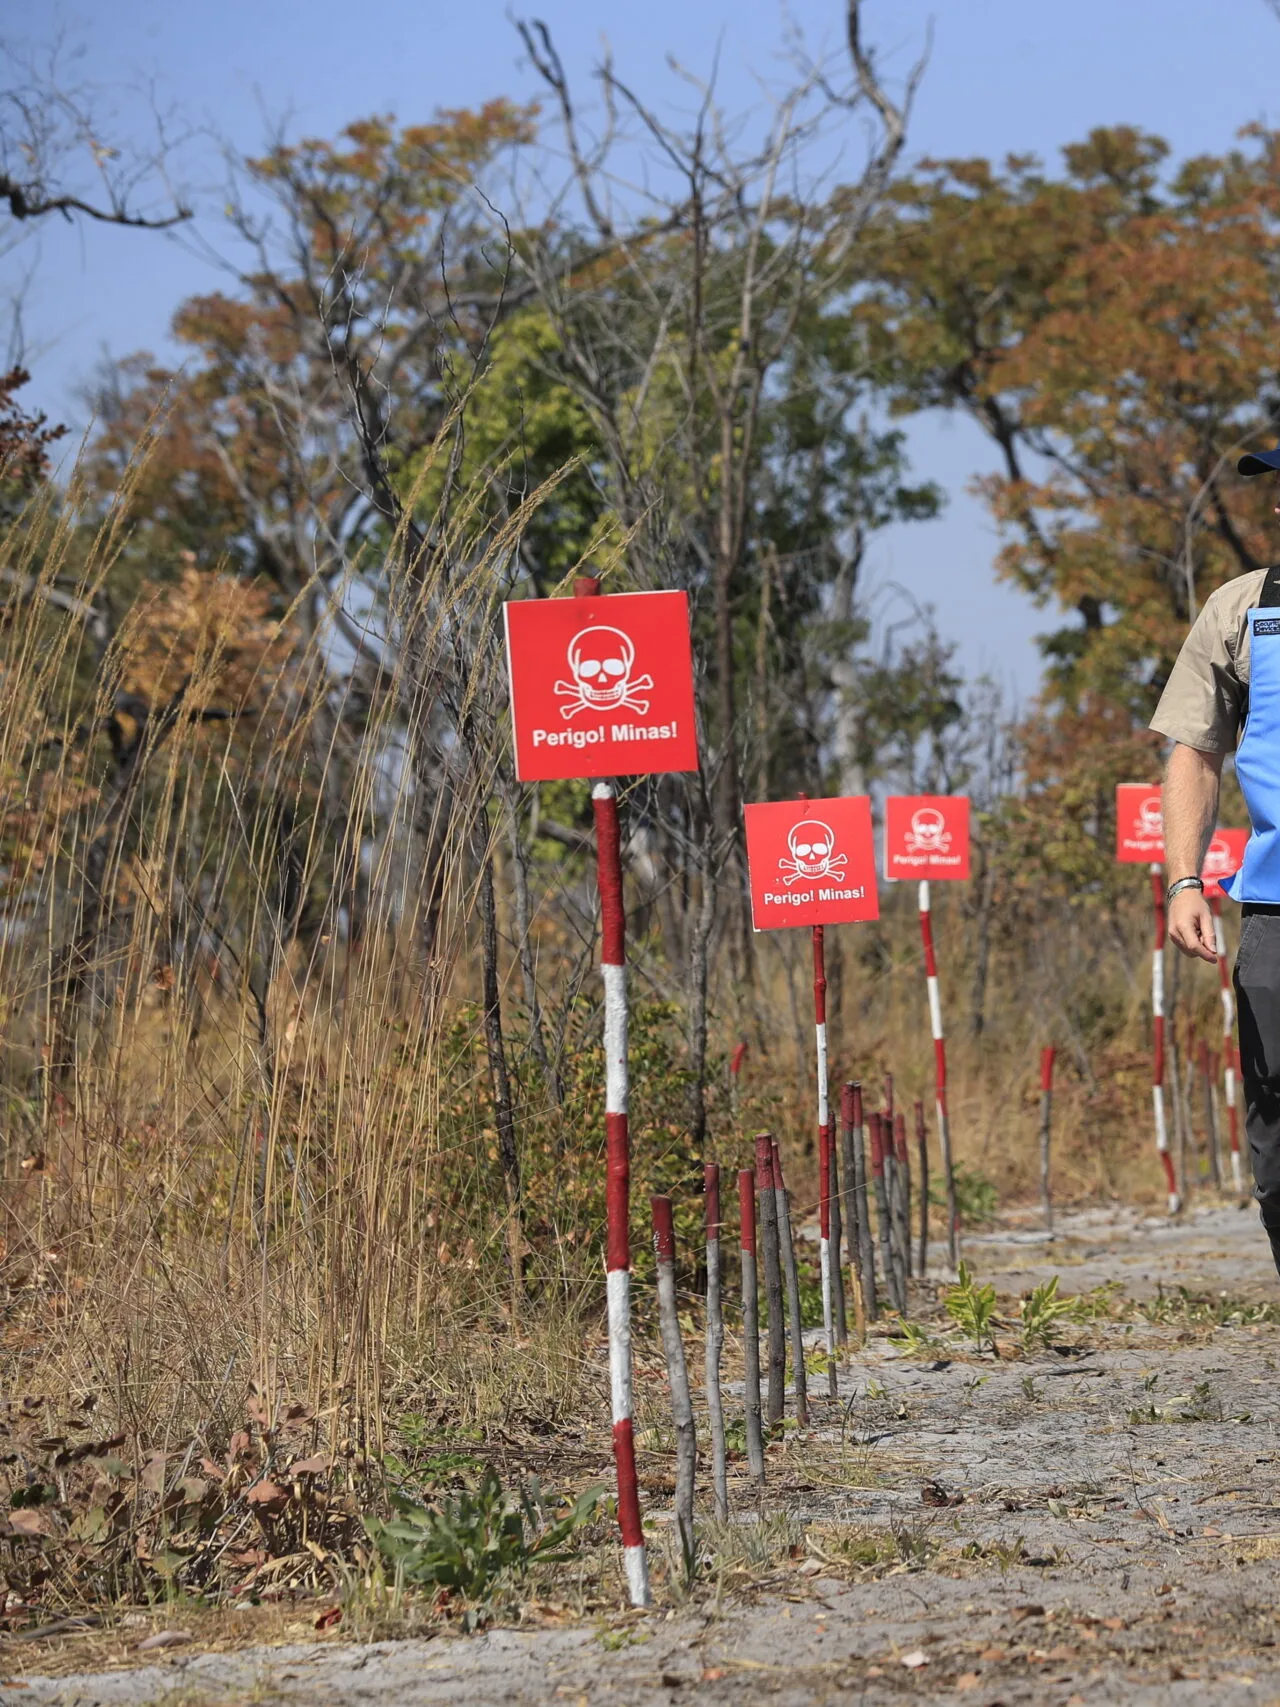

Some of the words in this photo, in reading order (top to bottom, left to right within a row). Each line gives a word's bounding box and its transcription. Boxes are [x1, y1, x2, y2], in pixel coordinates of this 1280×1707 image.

[532, 725, 605, 749] Perigo!
[611, 721, 678, 742] Minas!
[764, 891, 815, 906] Perigo!
[819, 886, 865, 901] Minas!
